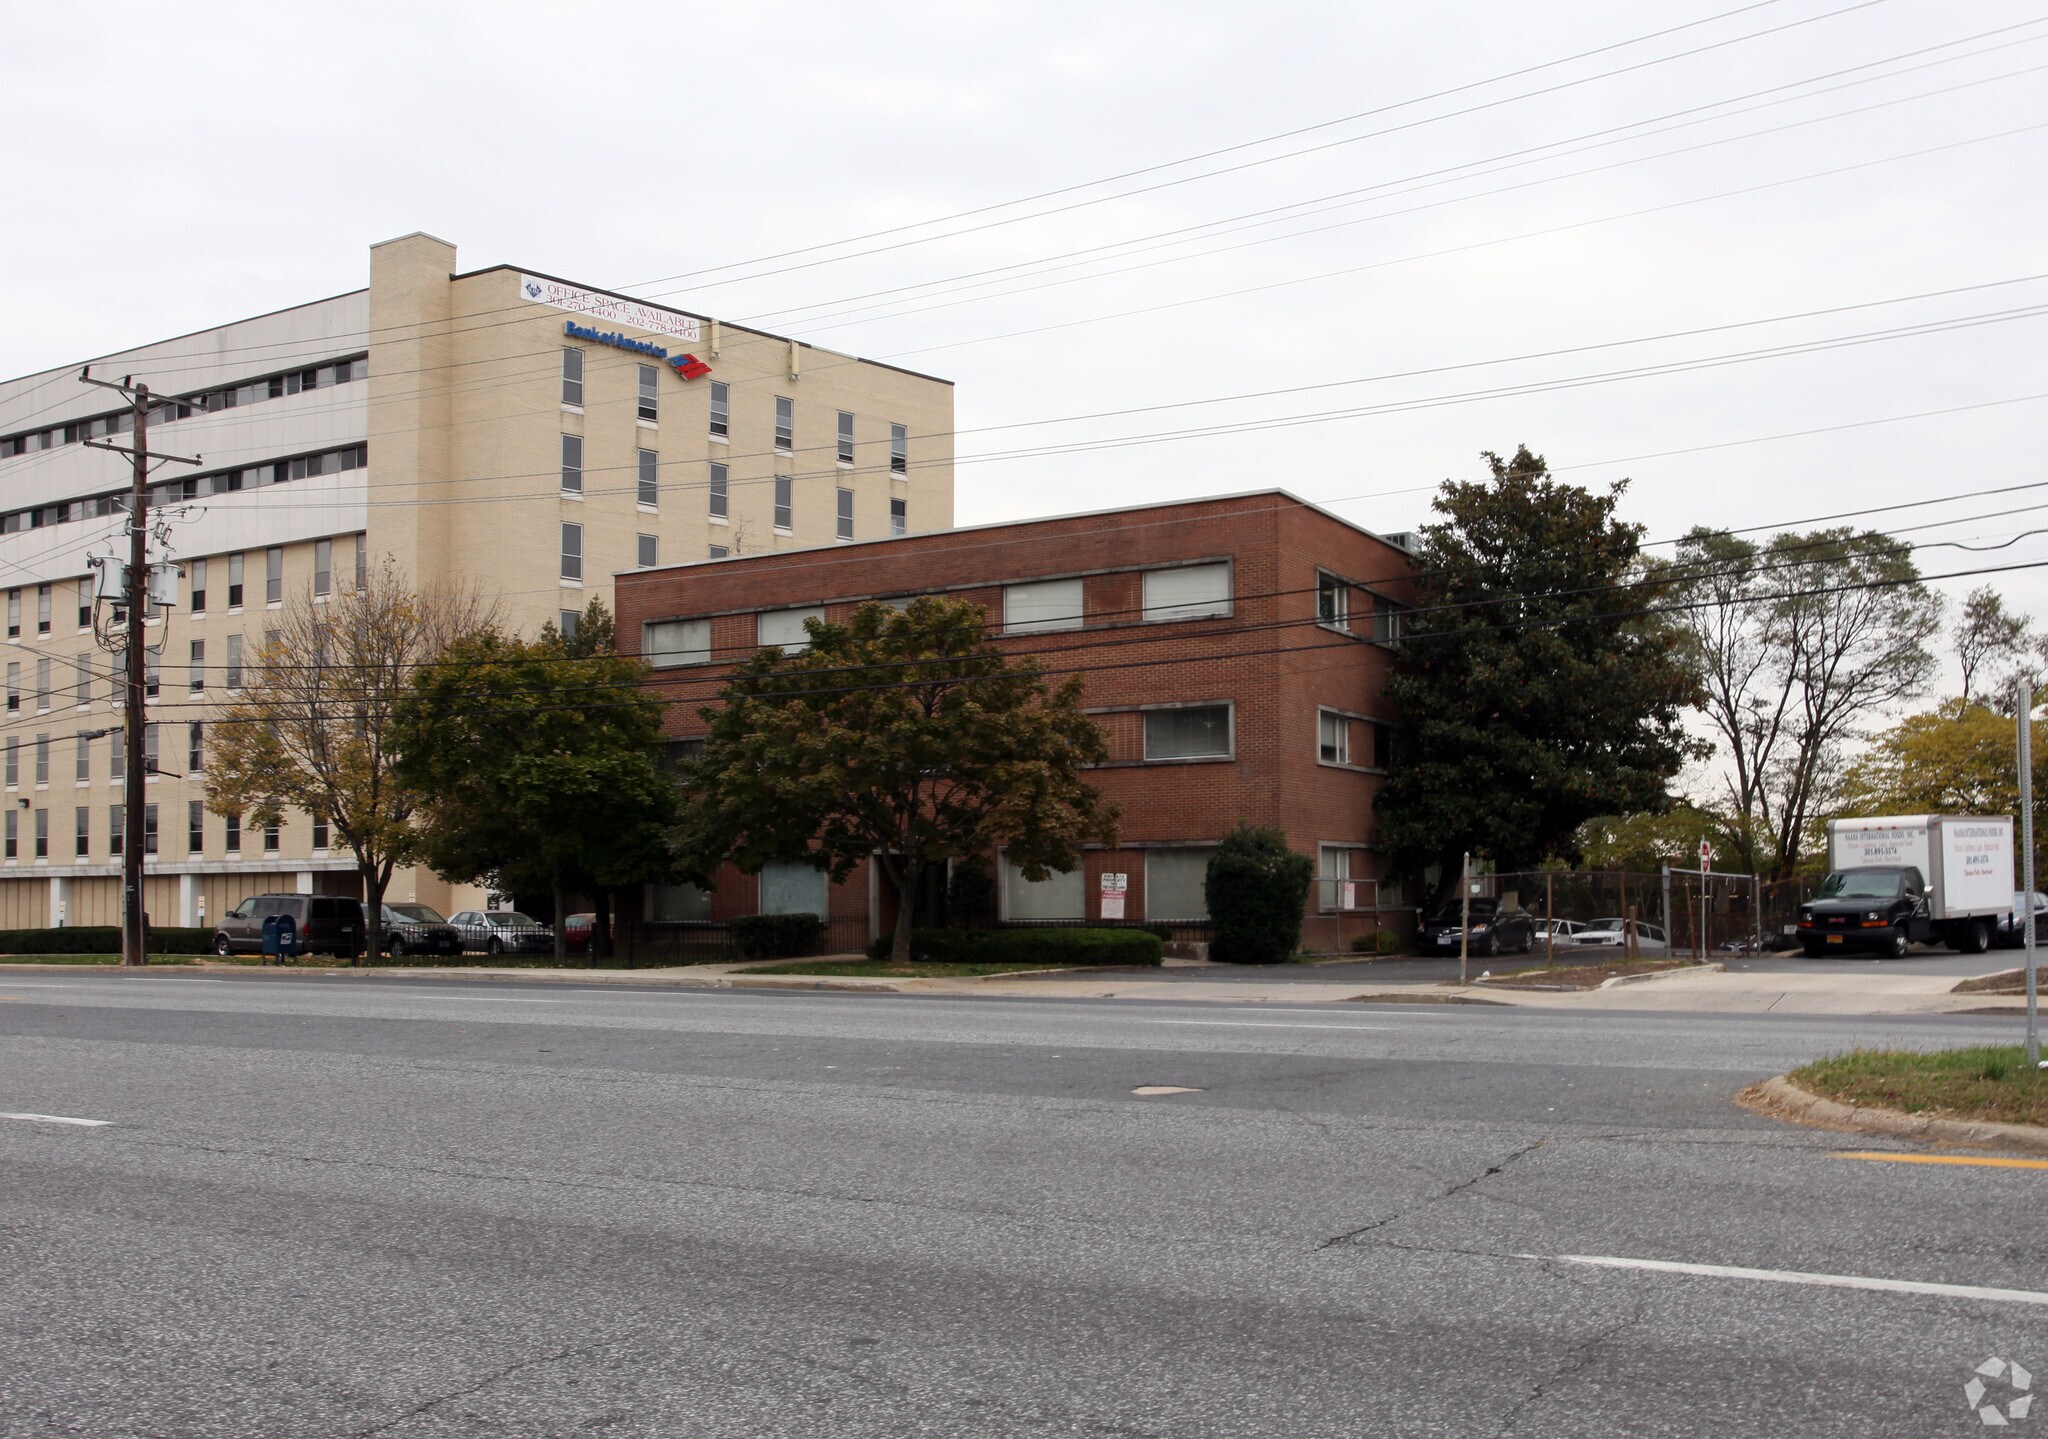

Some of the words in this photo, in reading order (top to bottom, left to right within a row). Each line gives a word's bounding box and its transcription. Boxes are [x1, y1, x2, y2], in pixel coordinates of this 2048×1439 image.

[547, 294, 617, 319] 301-270-4400
[626, 315, 697, 340] 202-778-0400
[548, 284, 590, 304] OFFICE
[594, 296, 631, 314] SPACE
[635, 307, 695, 330] AVAILABLE
[565, 320, 600, 340] Bank
[600, 331, 615, 344] of
[617, 333, 668, 358] America
